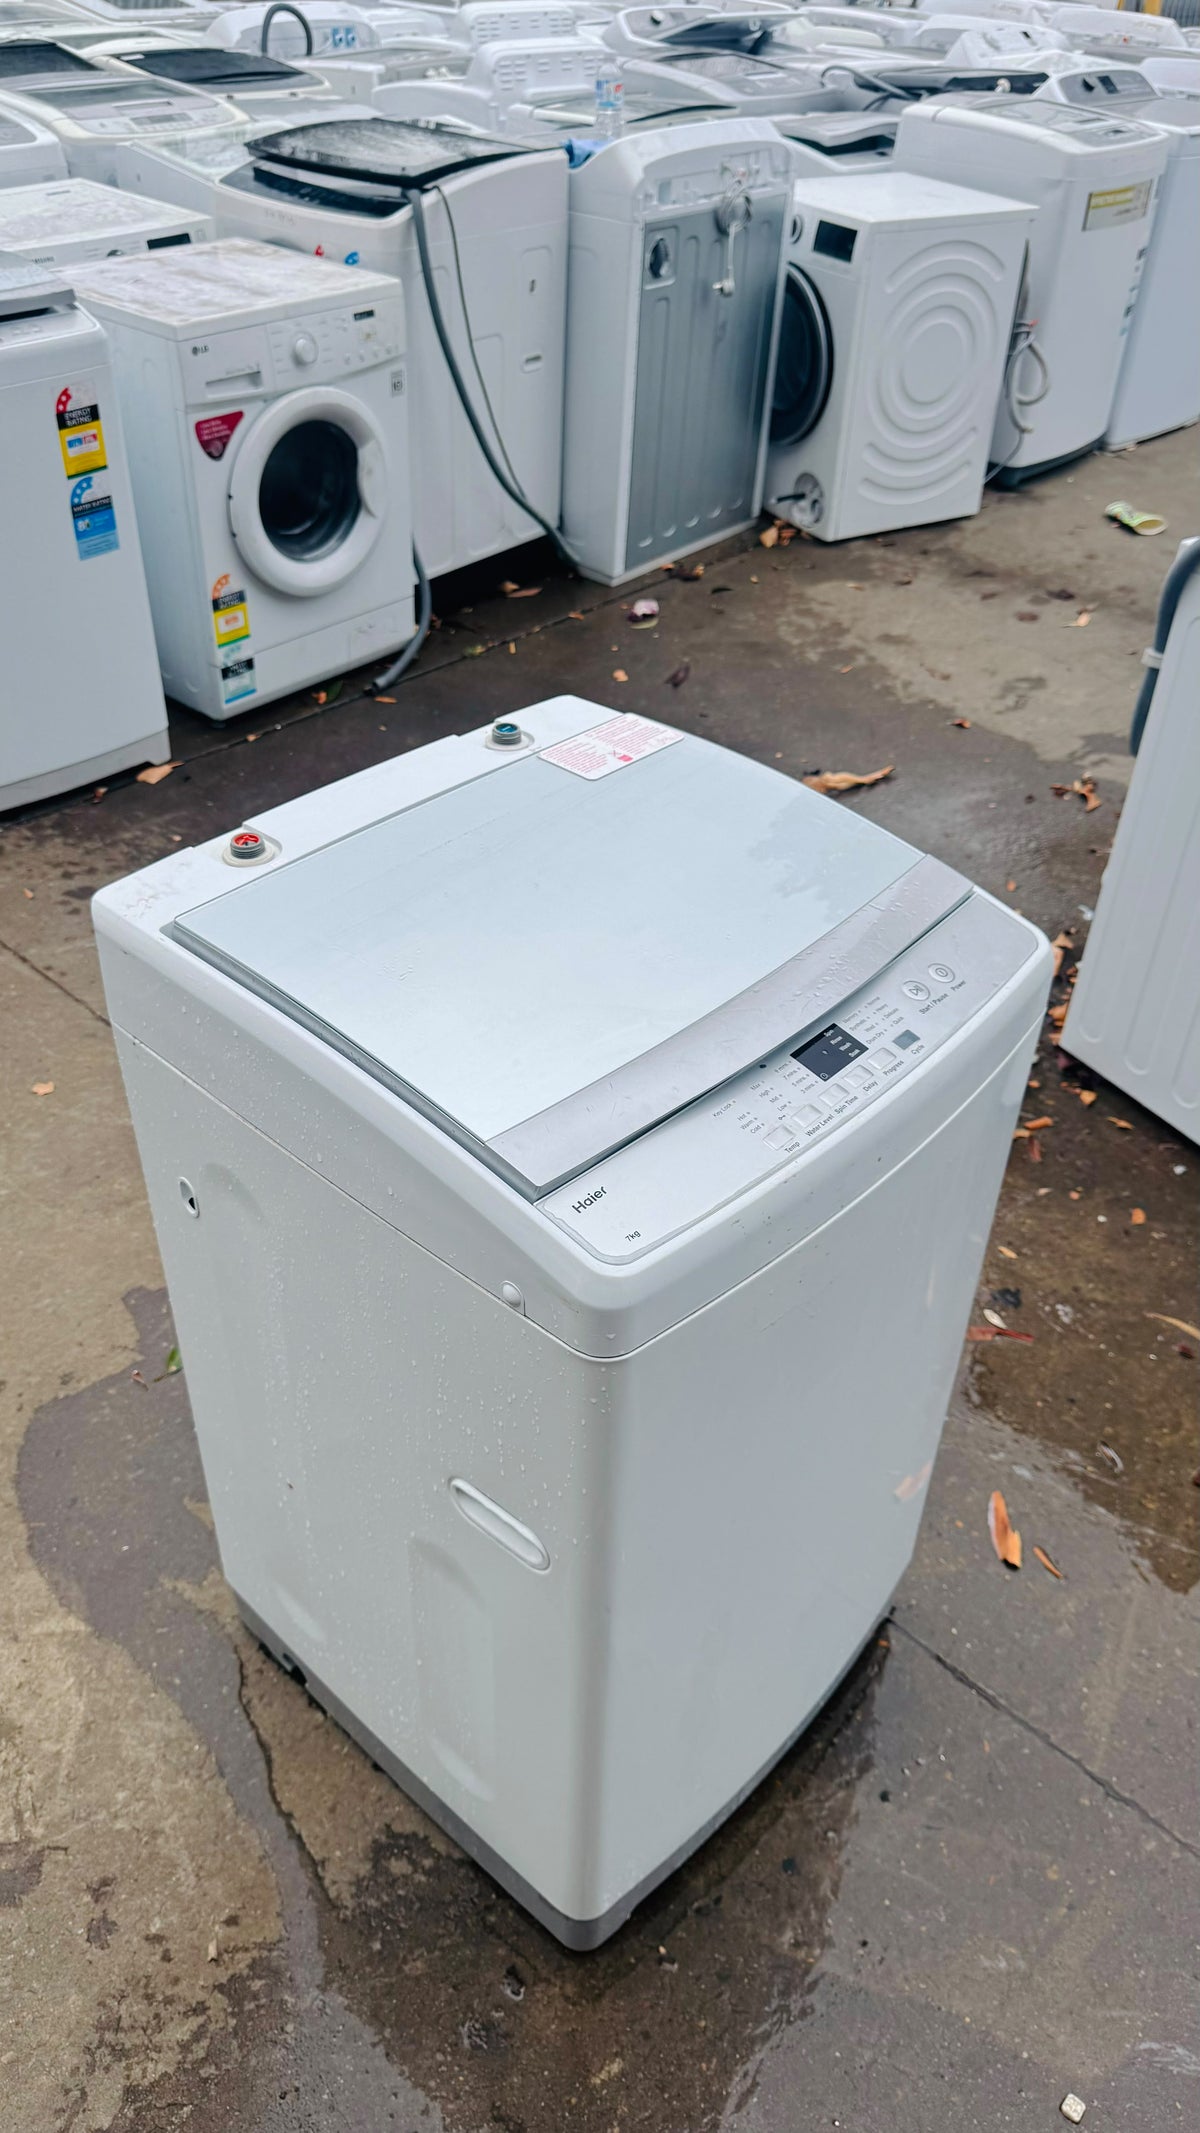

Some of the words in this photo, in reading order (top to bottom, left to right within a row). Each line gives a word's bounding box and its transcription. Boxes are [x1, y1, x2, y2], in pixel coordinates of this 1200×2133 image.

[950, 980, 966, 992] Power
[919, 1003, 932, 1015] Start
[932, 993, 949, 1006] Pause
[911, 1044, 925, 1055] Cycle
[883, 1060, 904, 1077] Progress
[863, 1081, 879, 1092] Delay
[777, 1103, 787, 1112] Low
[834, 1103, 847, 1116] Spin
[845, 1095, 859, 1107] Time
[737, 1112, 747, 1121] Hot
[740, 1119, 754, 1130] Warm
[750, 1124, 762, 1134] Cold
[805, 1122, 823, 1137] Water
[820, 1113, 835, 1127] Level
[784, 1141, 801, 1154] Temp
[571, 1186, 607, 1214] Haier
[624, 1230, 642, 1242] 7kg
